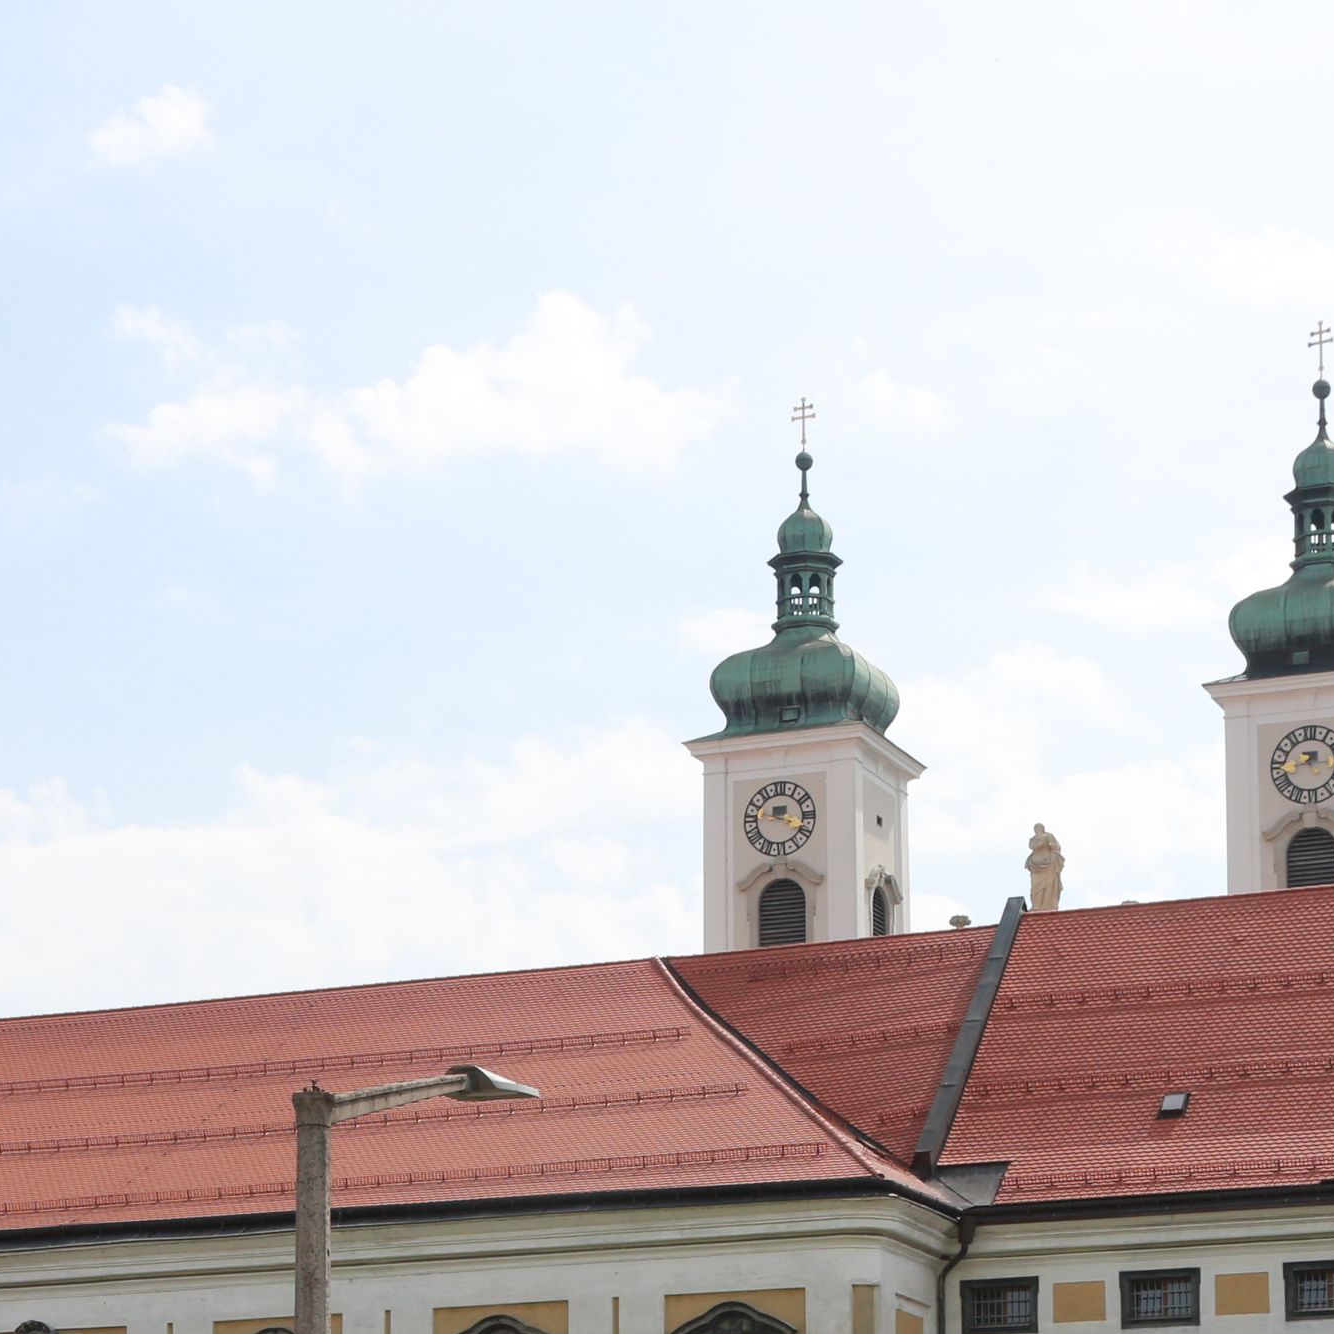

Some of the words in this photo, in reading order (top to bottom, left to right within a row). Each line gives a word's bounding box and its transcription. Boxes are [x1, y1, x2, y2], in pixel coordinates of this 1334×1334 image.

[1286, 731, 1299, 745] XI
[1304, 727, 1316, 740] XII
[1323, 729, 1330, 742] I
[1277, 745, 1289, 755] X
[775, 783, 786, 795] XII
[1273, 773, 1292, 792] VIII
[758, 787, 770, 800] XI
[791, 785, 797, 797] I
[1290, 786, 1303, 802] VII
[1308, 789, 1317, 803] VI
[1324, 783, 1333, 796] V
[750, 800, 760, 809] X
[798, 792, 811, 804] II
[745, 813, 757, 823] IX
[803, 811, 815, 819] III
[747, 827, 763, 845] VIII
[791, 836, 800, 849] V
[761, 839, 773, 855] VII
[777, 843, 786, 855] VI
